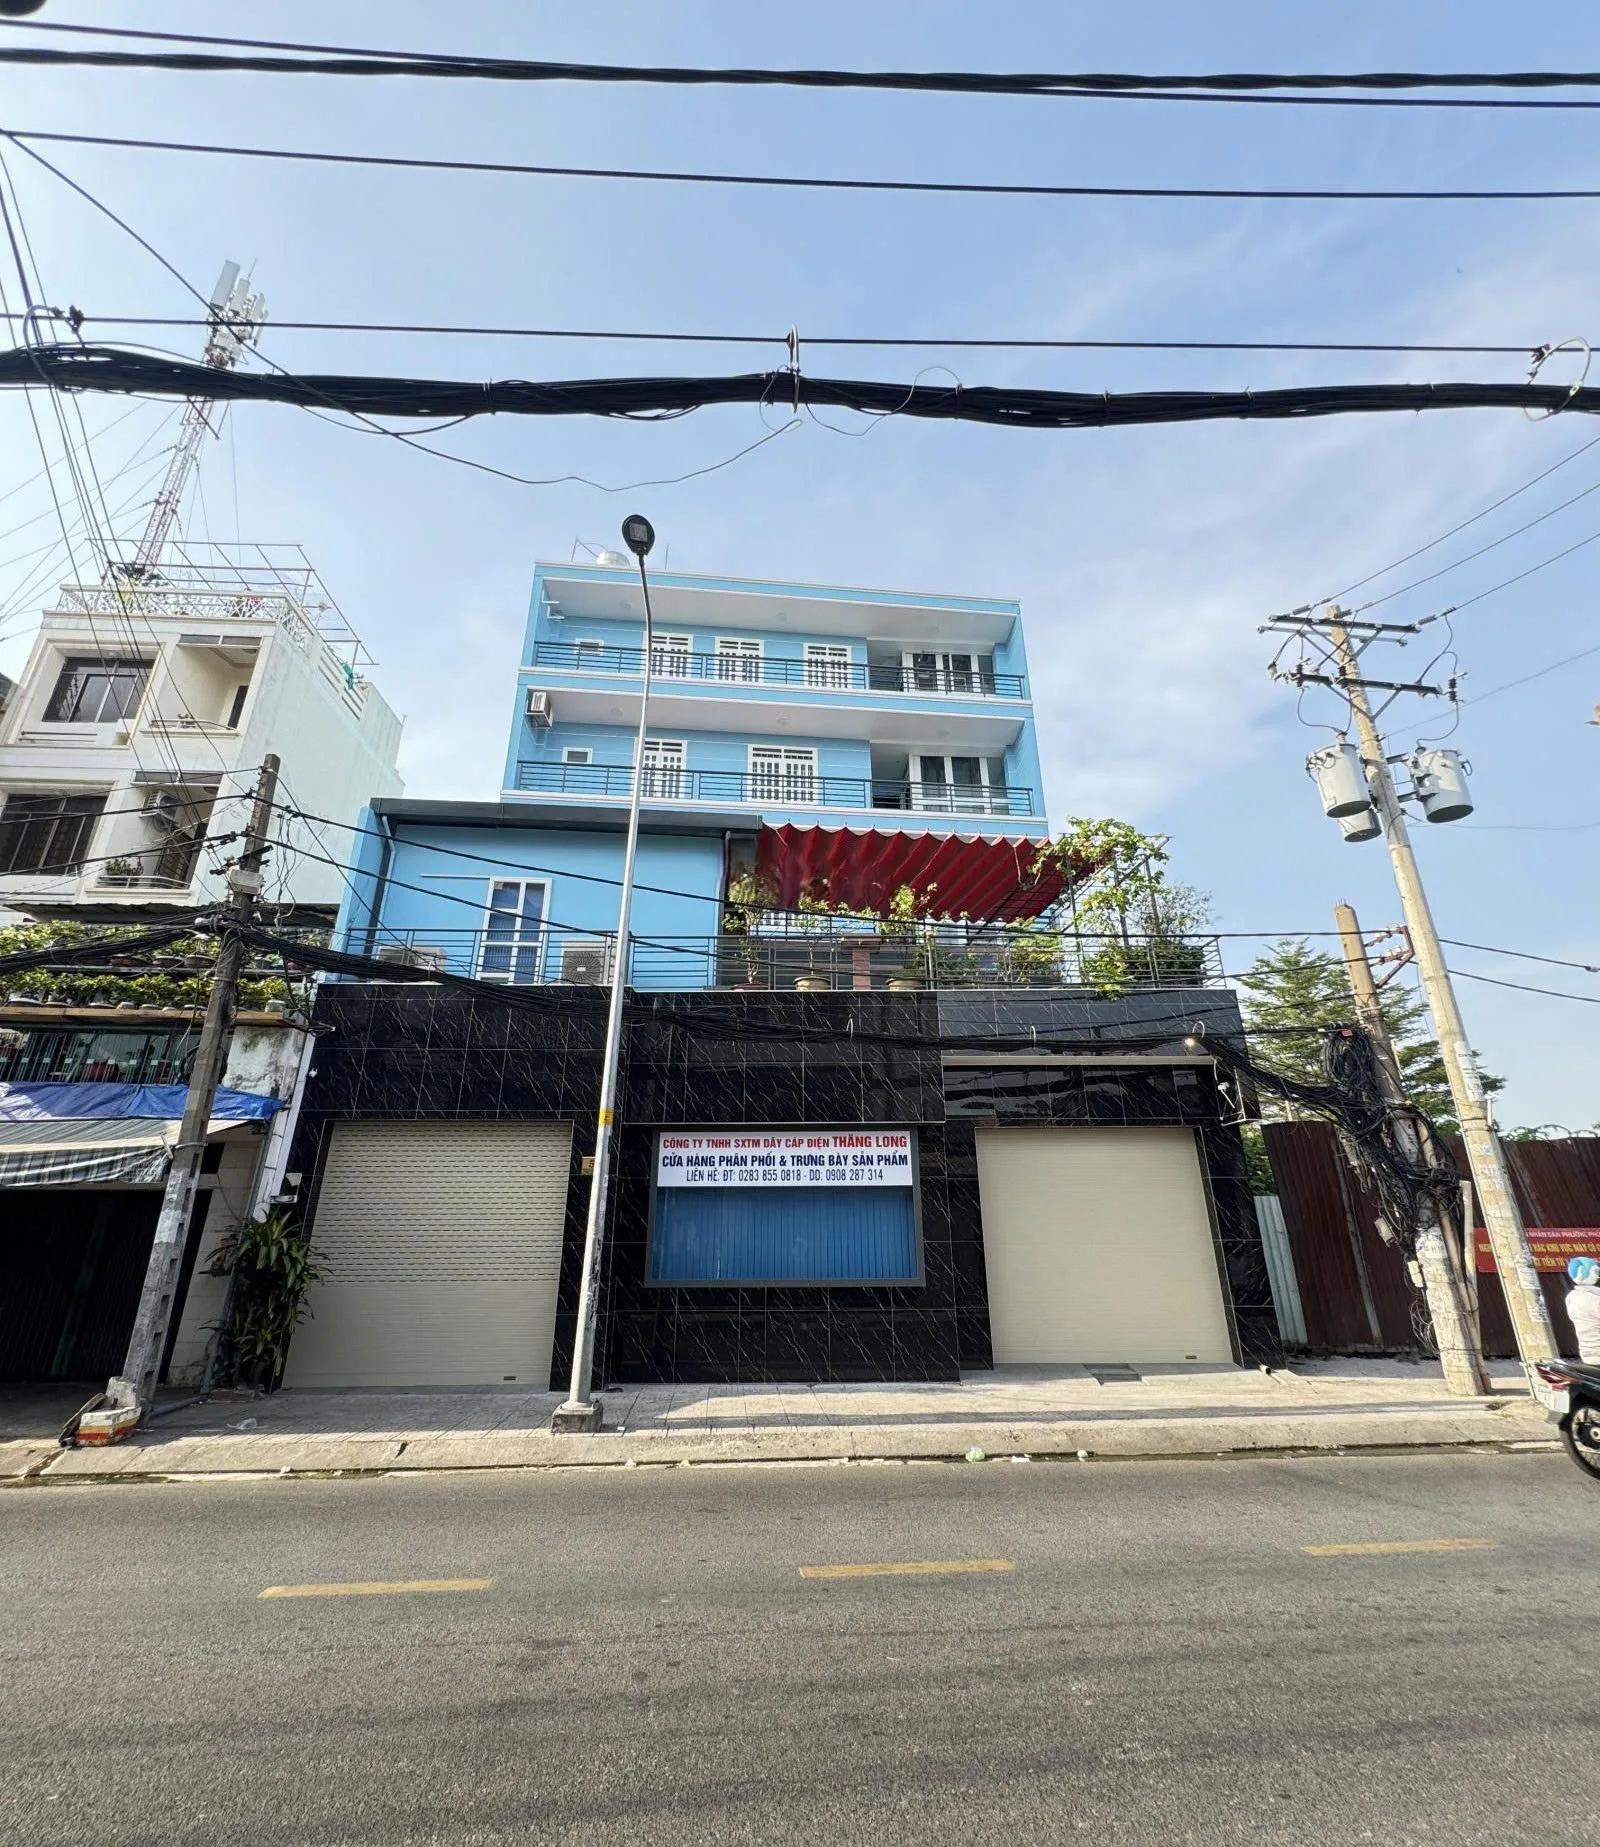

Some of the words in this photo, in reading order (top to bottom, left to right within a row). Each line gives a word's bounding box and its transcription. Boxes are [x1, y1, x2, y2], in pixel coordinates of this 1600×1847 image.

[663, 1137, 689, 1148] CÔNG
[692, 1138, 704, 1148] TY
[706, 1138, 731, 1148] TNHH
[734, 1138, 760, 1148] SXTM
[763, 1136, 782, 1148] DÂY
[785, 1136, 804, 1148] CÁP
[807, 1136, 830, 1150] ĐIỆN
[832, 1134, 872, 1148] THĂNG
[875, 1136, 907, 1148] LONG
[662, 1152, 683, 1167] CỬA
[686, 1152, 716, 1167] HÀNG
[719, 1152, 747, 1167] PHÂN
[751, 1151, 775, 1167] PHỐI
[778, 1155, 787, 1167] &
[790, 1154, 825, 1166] TRƯNG
[828, 1152, 848, 1166] BÀY
[852, 1151, 873, 1166] SẢN
[877, 1150, 908, 1166] PHẨM
[686, 1167, 704, 1181] LIÊN
[707, 1167, 720, 1184] HỆ:
[723, 1169, 736, 1181] ĐT:
[739, 1169, 759, 1181] 0283
[762, 1169, 778, 1181] 855
[780, 1168, 801, 1181] 0818
[825, 1168, 847, 1180] 0908
[849, 1168, 864, 1180] 287
[867, 1168, 883, 1180] 314
